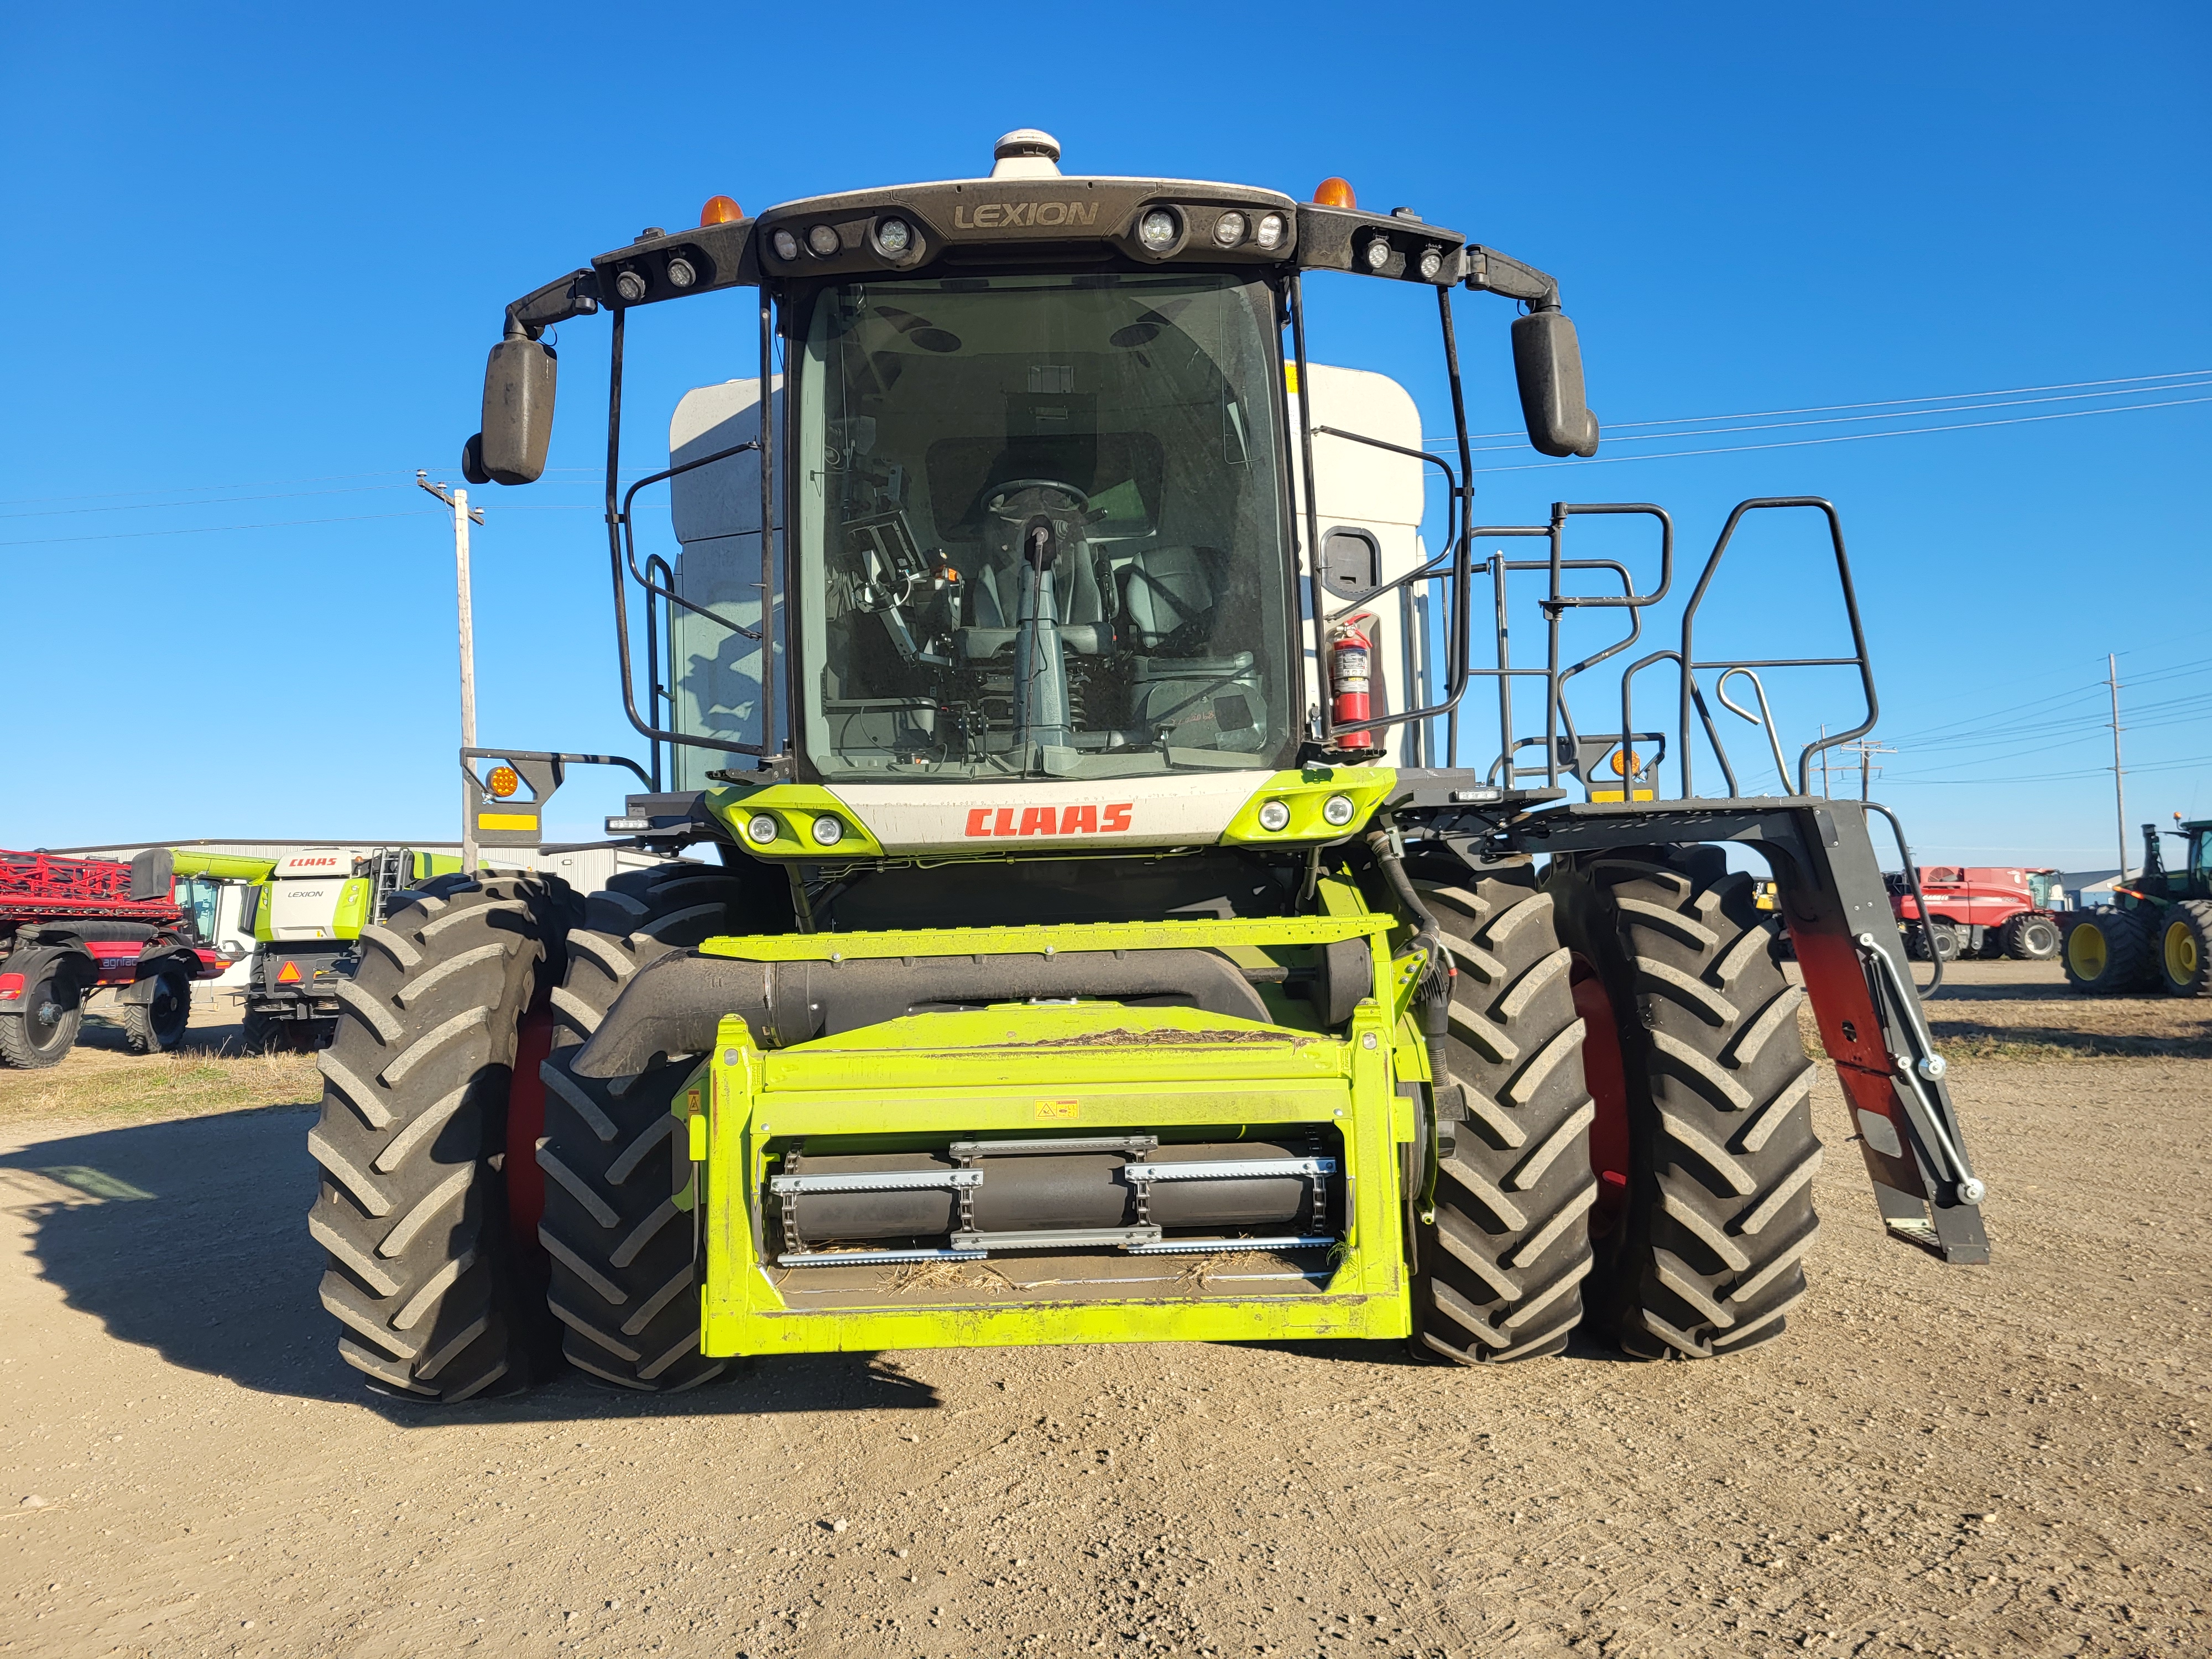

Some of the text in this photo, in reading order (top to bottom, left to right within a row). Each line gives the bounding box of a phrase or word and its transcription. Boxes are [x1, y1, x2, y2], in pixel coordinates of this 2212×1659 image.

[954, 202, 1099, 229] LEXION
[964, 803, 1134, 837] CLAAS
[289, 858, 337, 867] CLAAS
